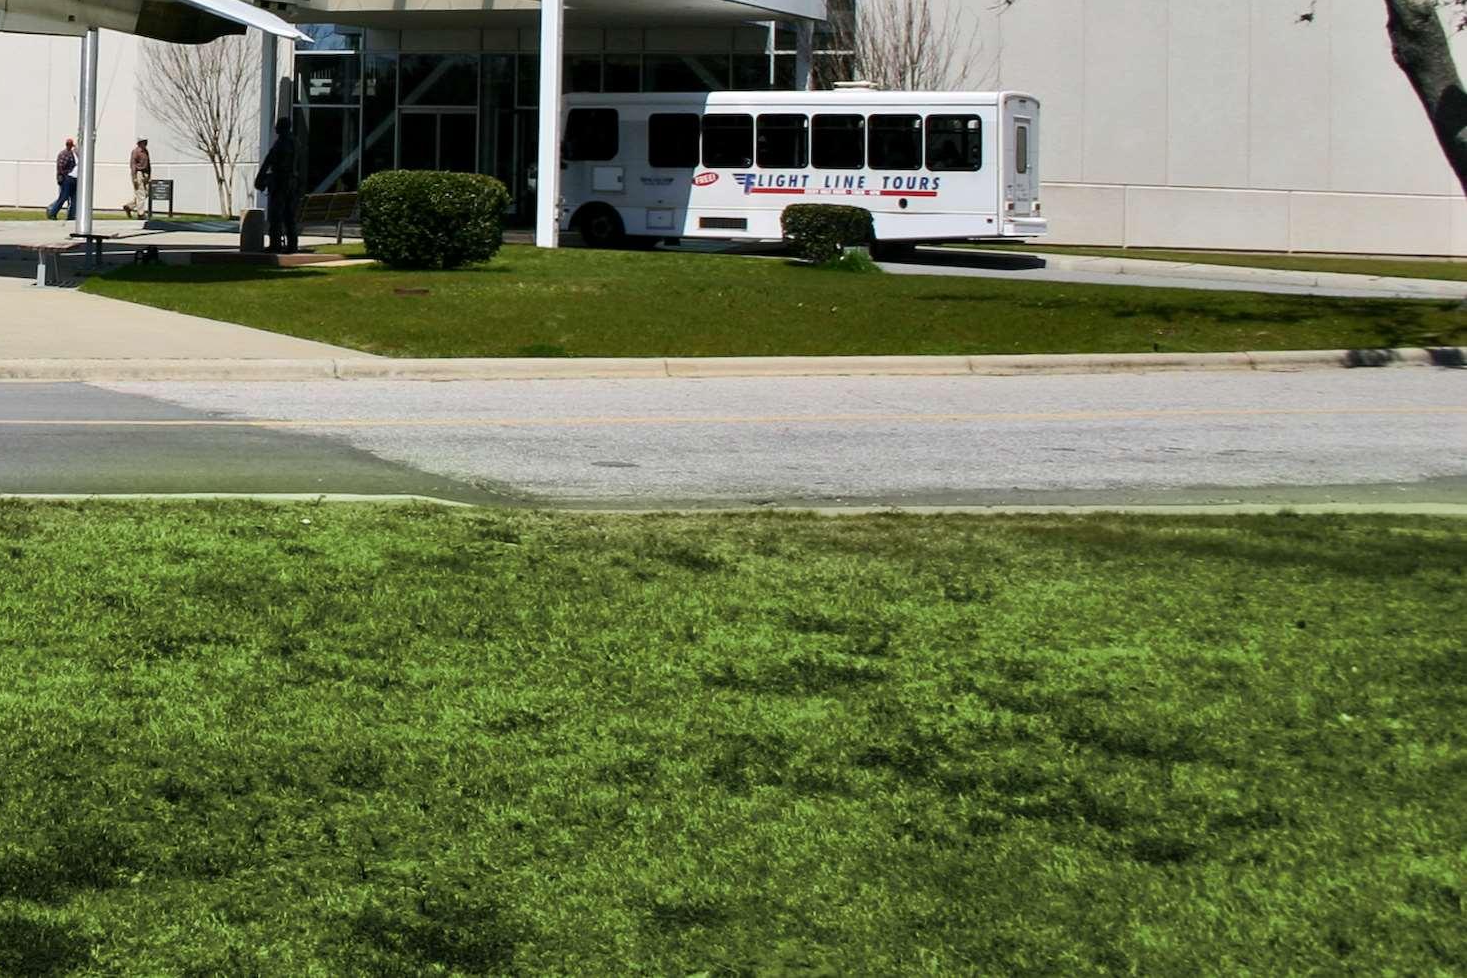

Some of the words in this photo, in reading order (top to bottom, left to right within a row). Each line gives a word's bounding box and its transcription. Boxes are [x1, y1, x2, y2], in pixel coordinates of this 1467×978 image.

[744, 174, 810, 195] FLIGHT
[824, 175, 866, 189] LINE
[882, 176, 940, 191] TOURS
